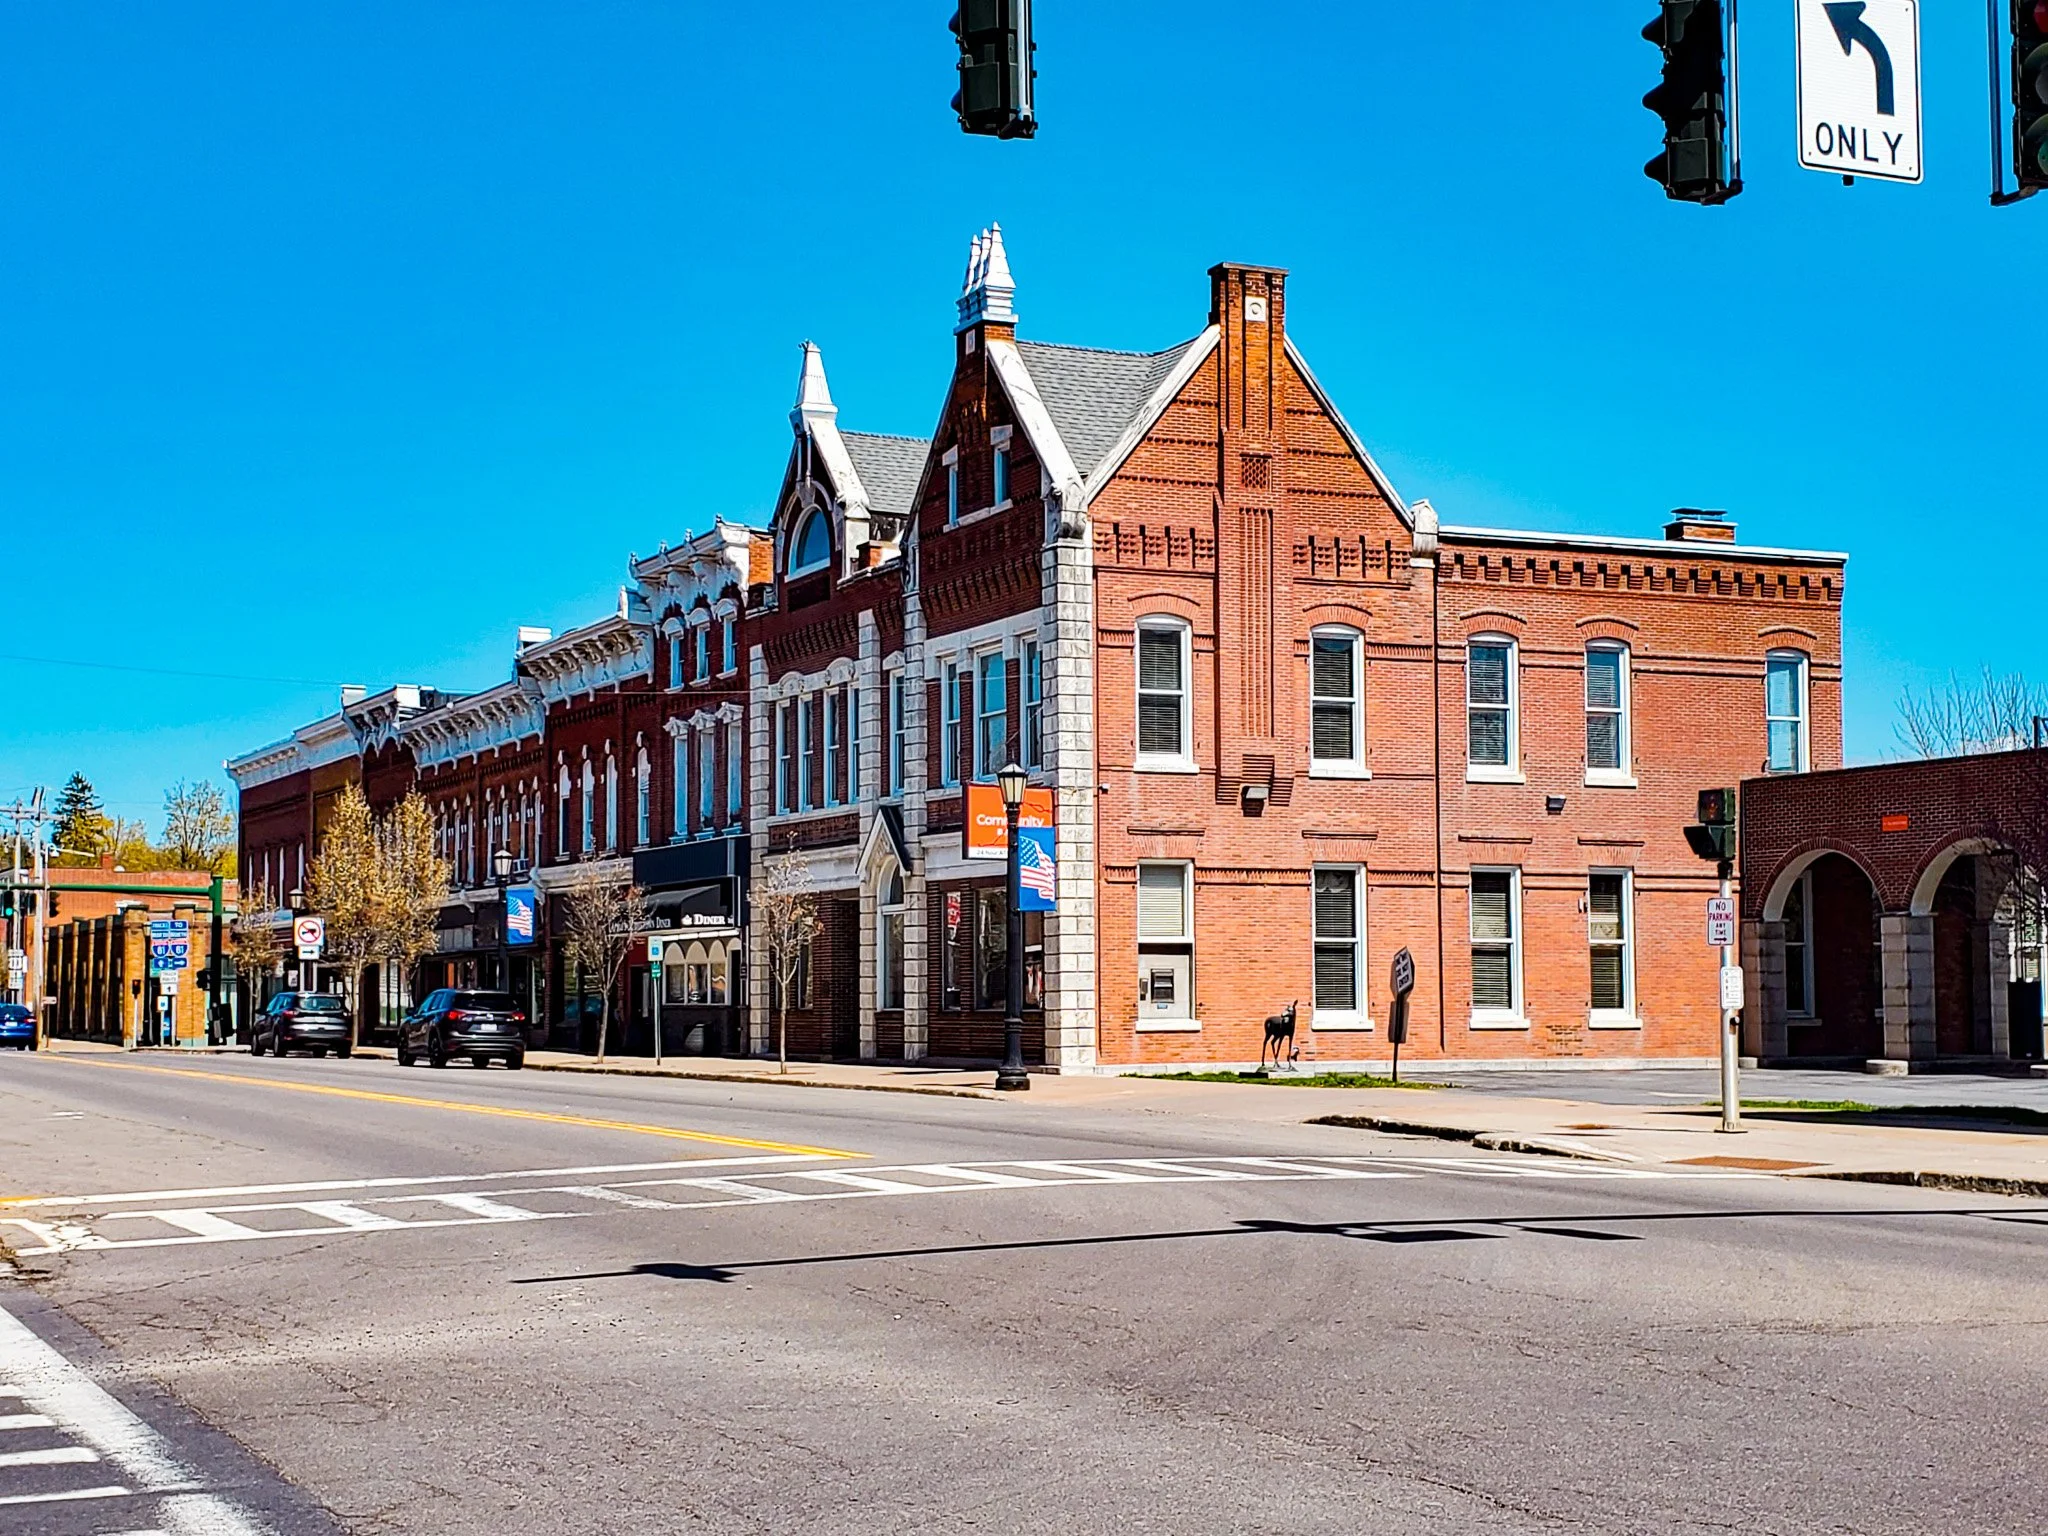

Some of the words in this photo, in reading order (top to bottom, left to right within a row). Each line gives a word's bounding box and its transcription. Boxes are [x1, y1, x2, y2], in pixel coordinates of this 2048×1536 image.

[1815, 122, 1903, 165] ONLY
[1715, 902, 1726, 911] NO
[693, 913, 726, 925] DINER
[1709, 912, 1733, 921] PARKING
